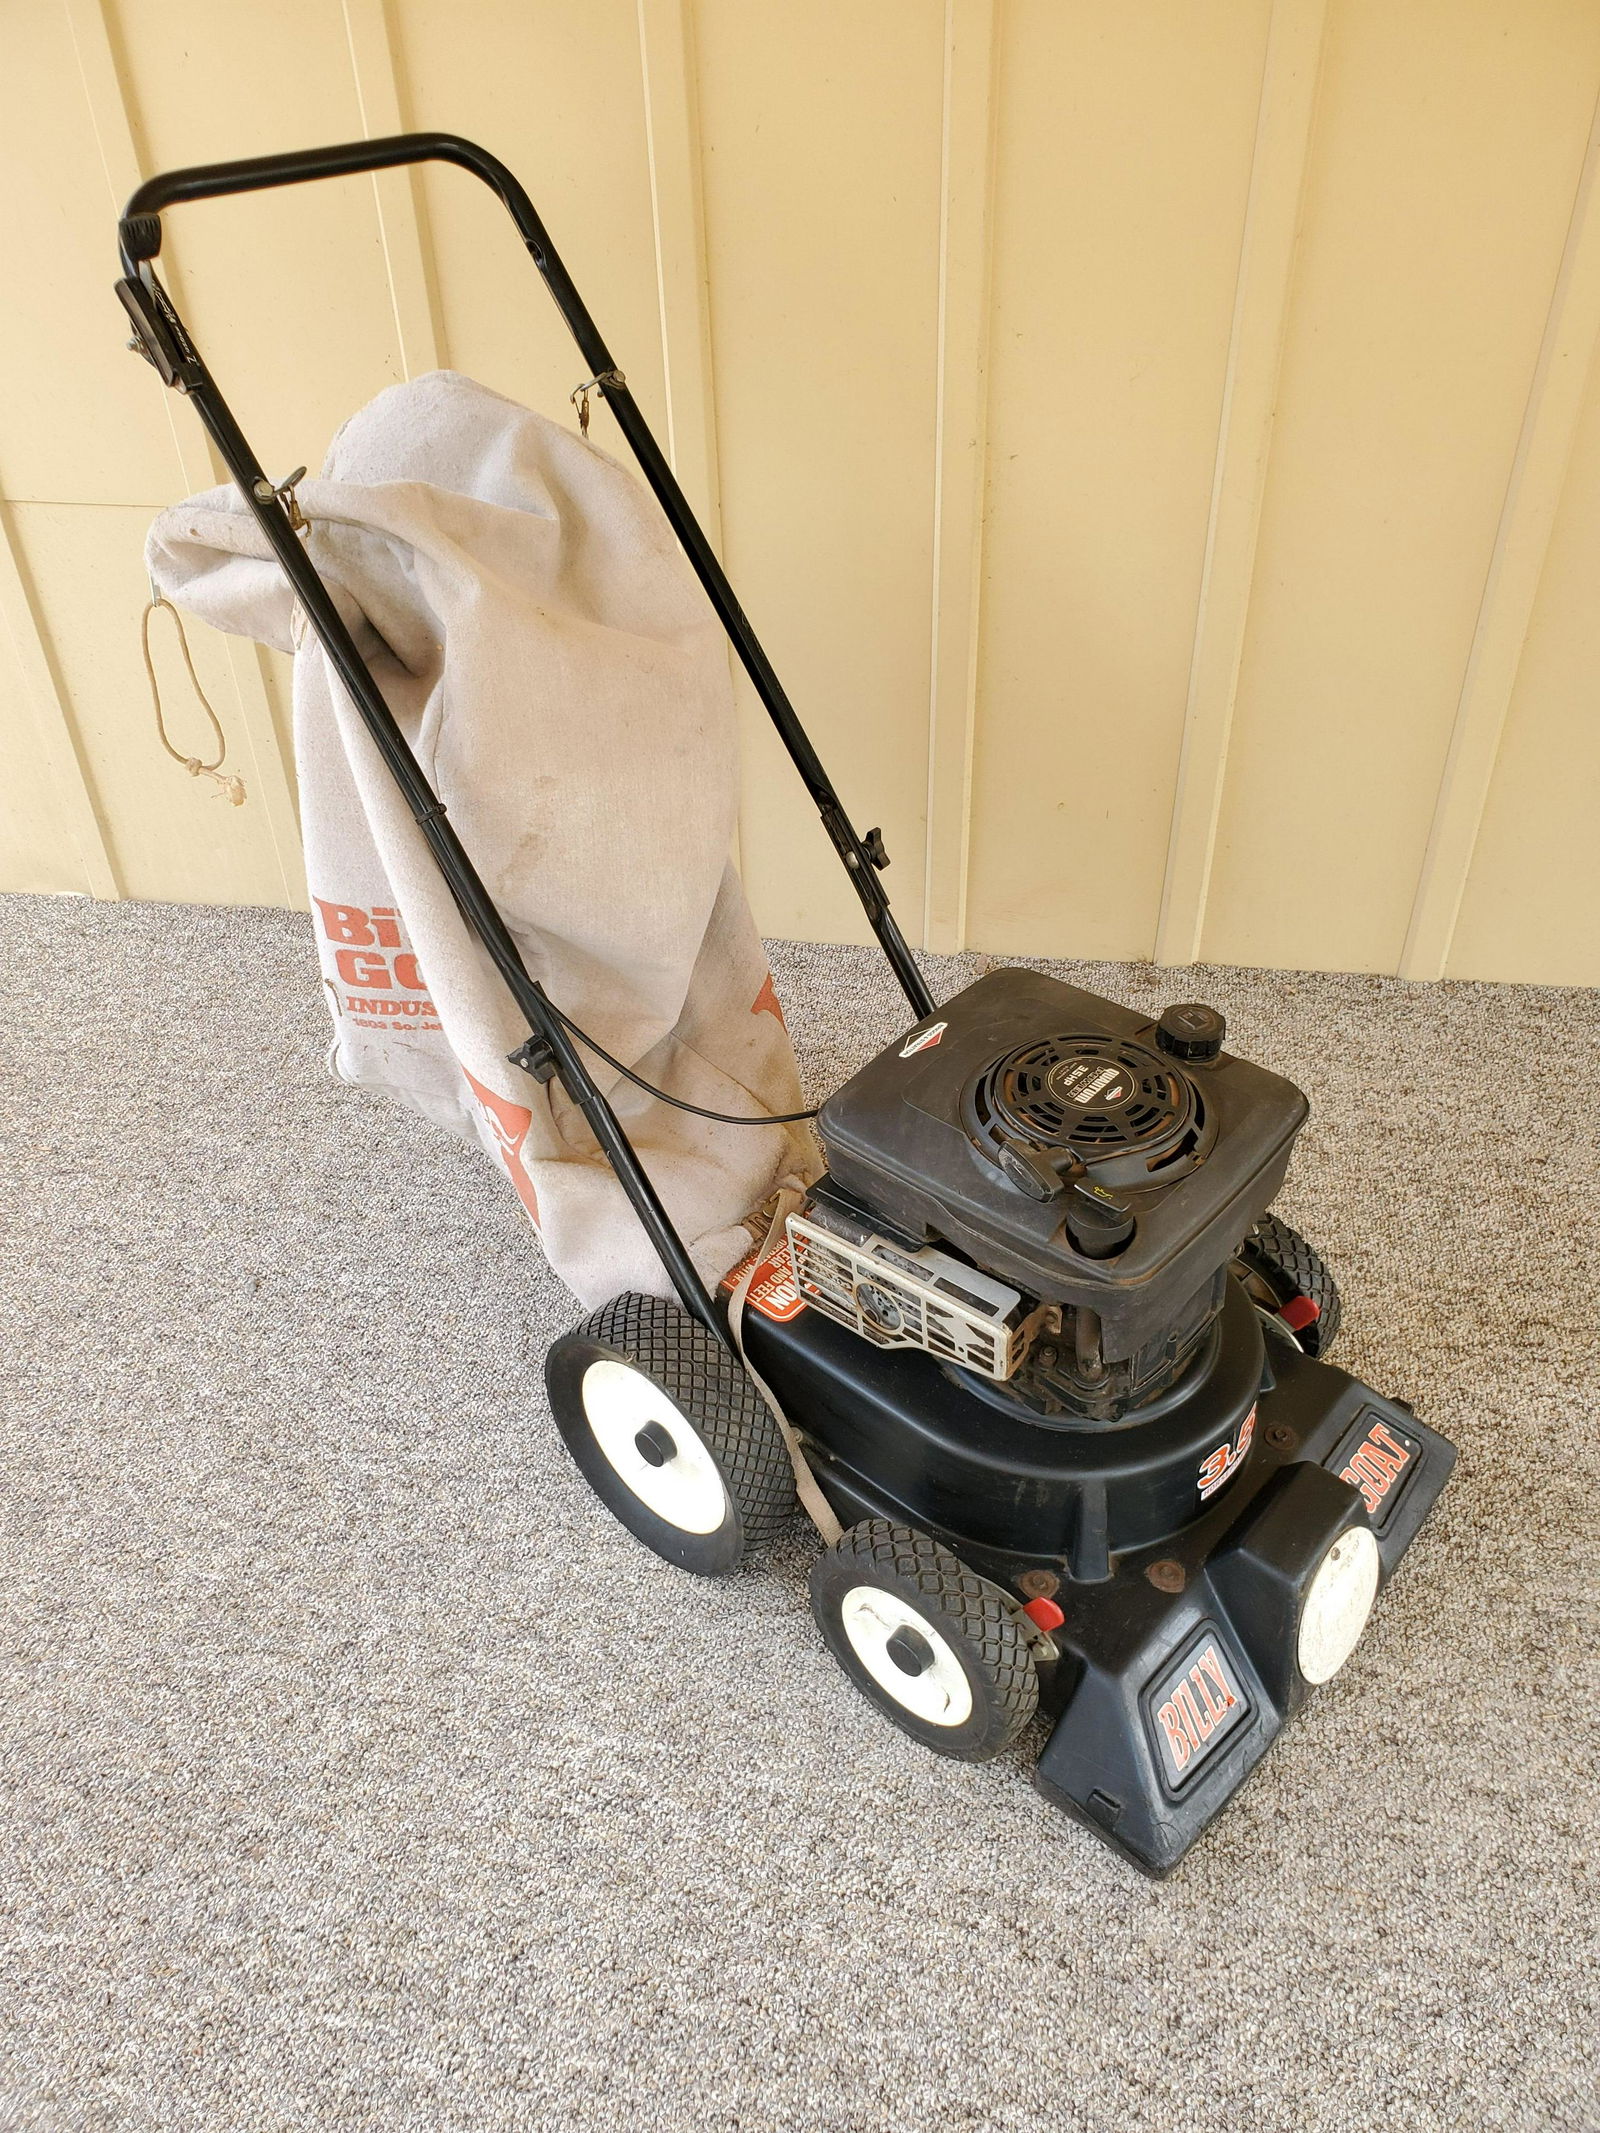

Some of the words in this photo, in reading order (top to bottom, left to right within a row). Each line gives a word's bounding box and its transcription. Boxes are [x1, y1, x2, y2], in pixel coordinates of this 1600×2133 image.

[1074, 1068, 1120, 1104] QUANTUM
[768, 1246, 791, 1268] LEAR
[770, 1266, 792, 1284] AND
[750, 1280, 775, 1302] FEET
[1157, 1645, 1238, 1772] BILLY
